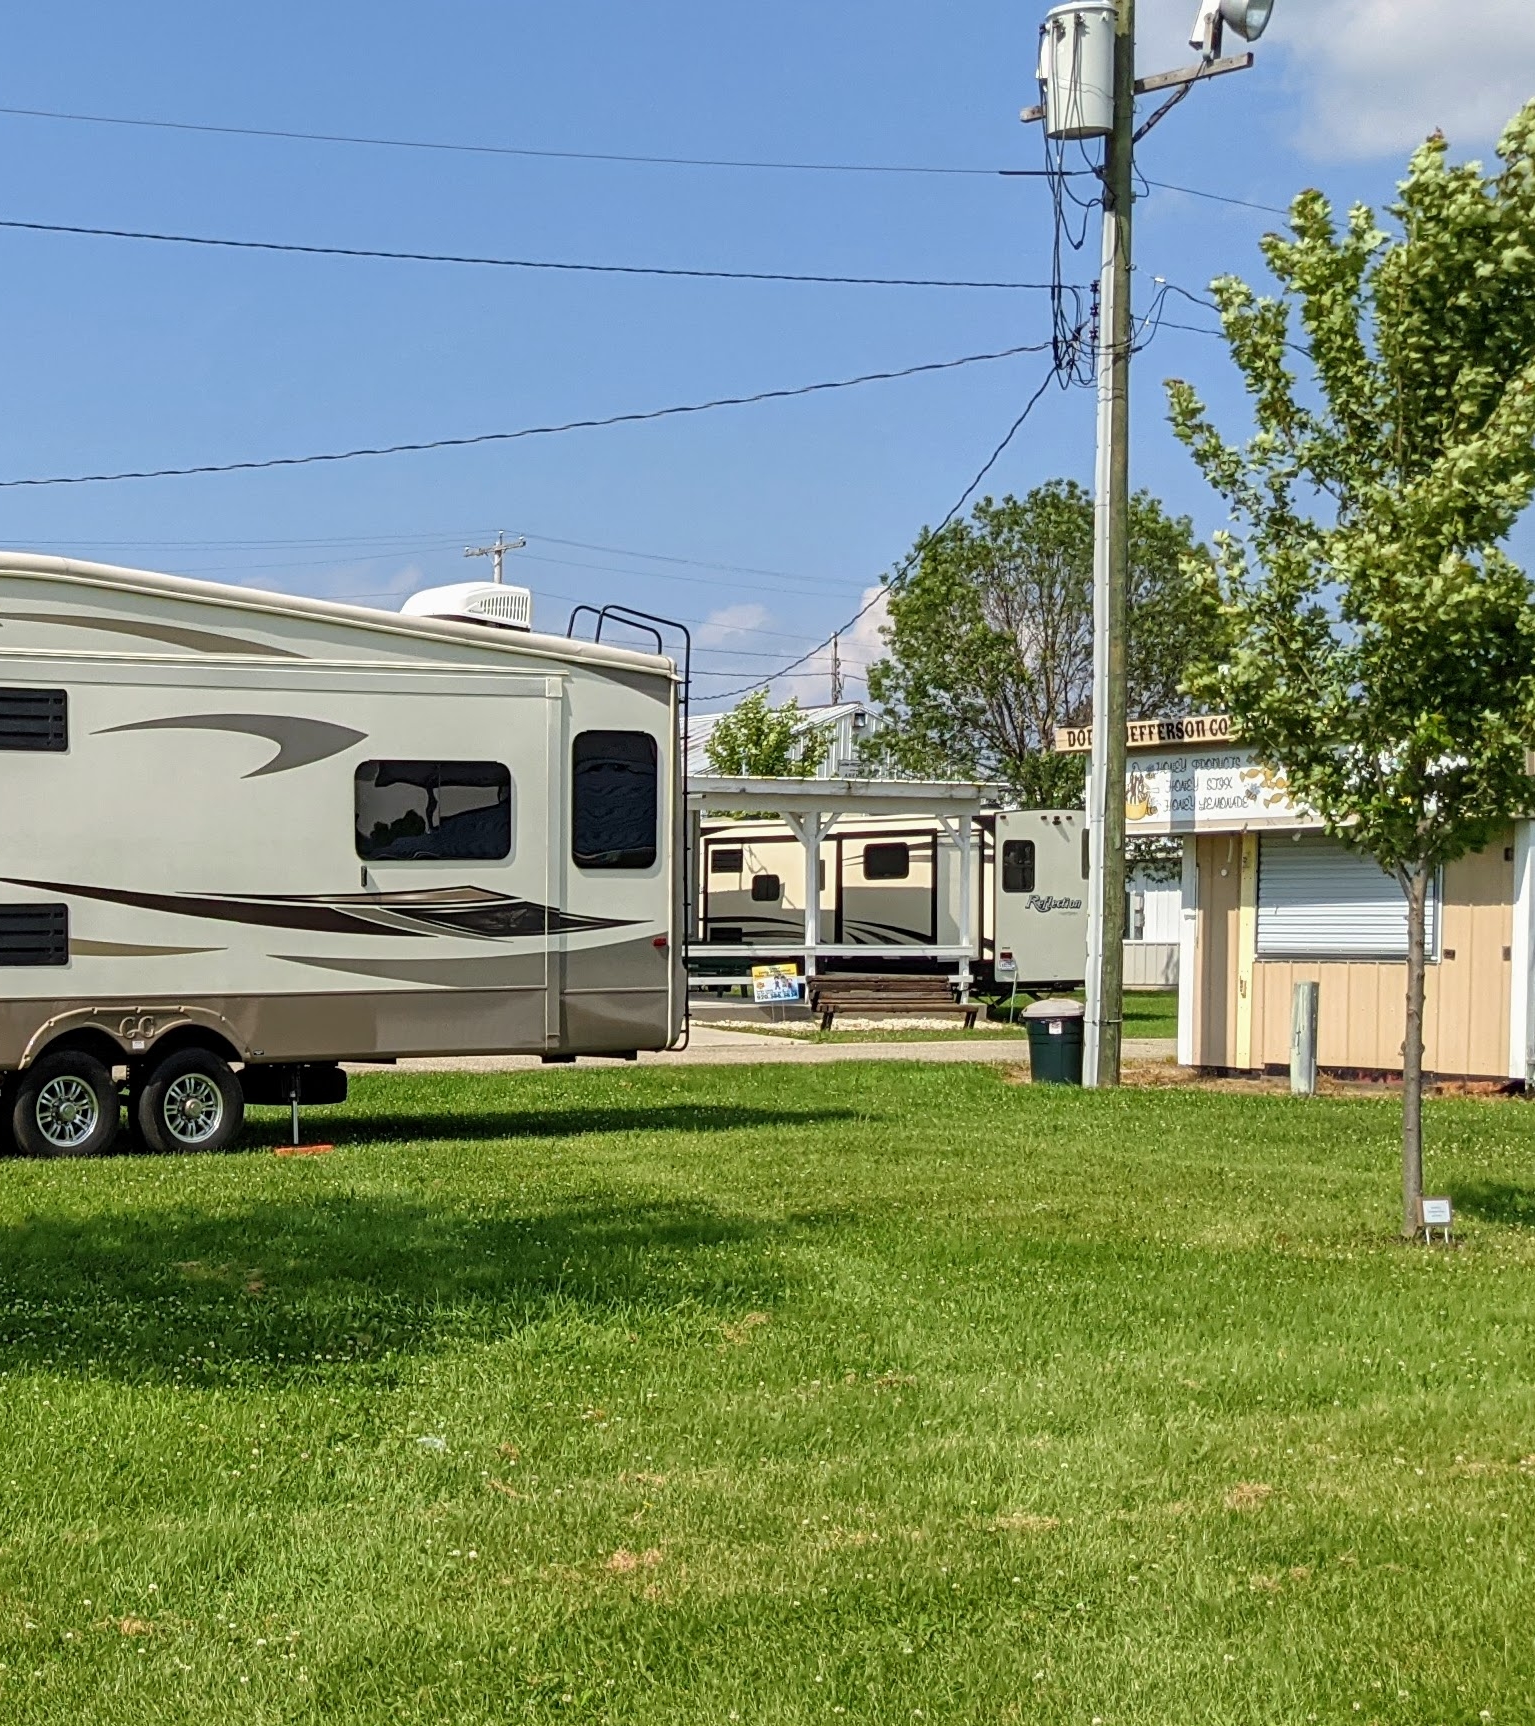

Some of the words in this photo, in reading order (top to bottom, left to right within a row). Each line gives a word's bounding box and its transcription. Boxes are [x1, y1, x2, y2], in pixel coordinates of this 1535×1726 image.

[1126, 719, 1206, 743] EFFERSON
[1156, 758, 1187, 773] HONEY
[1191, 756, 1241, 770] PRODUCTS
[1165, 776, 1199, 793] HONEY
[1163, 795, 1196, 812] HONEY
[1198, 796, 1249, 811] LEMONADE
[1025, 894, 1082, 913] Reflection
